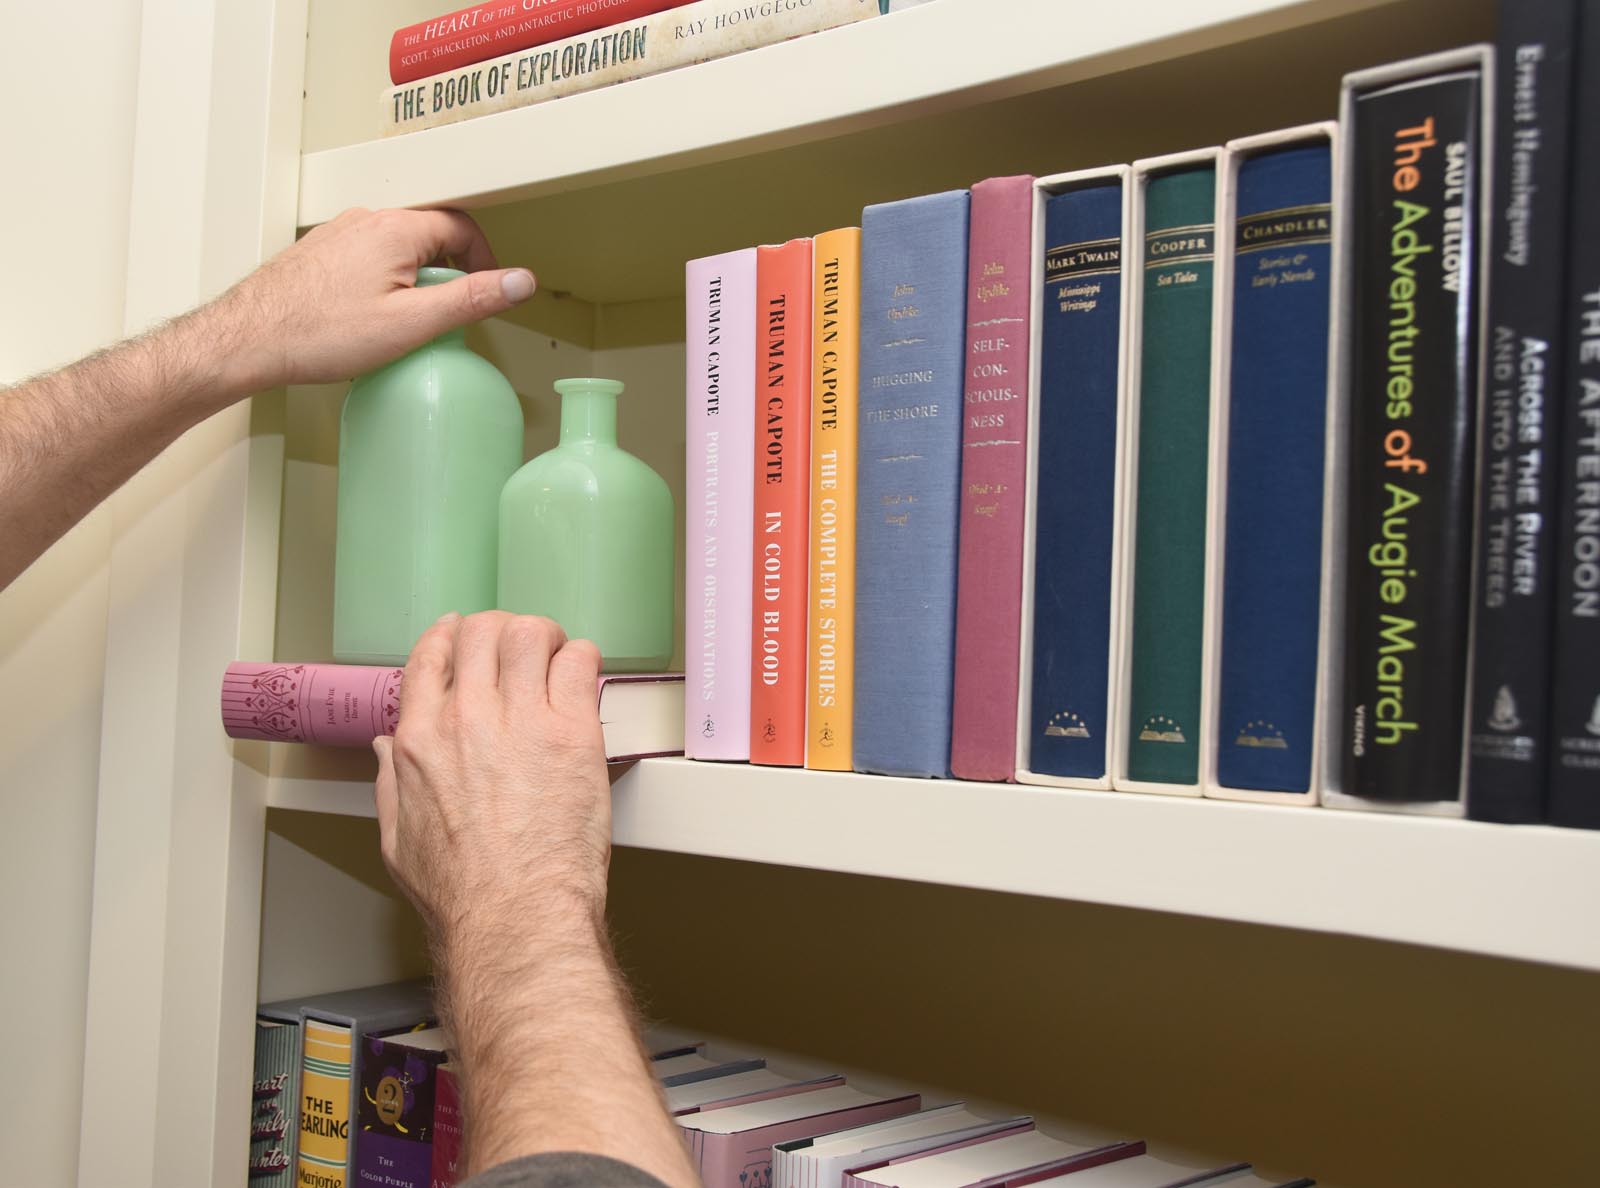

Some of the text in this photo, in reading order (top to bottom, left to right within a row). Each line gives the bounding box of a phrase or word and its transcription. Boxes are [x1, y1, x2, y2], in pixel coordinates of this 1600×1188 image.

[403, 6, 516, 47] THE HEART OF THE
[495, 25, 516, 40] AND
[518, 9, 574, 33] ANTARCTIC
[674, 19, 707, 40] RAY
[393, 26, 647, 123] THE BOOK OF EXPLORATION
[1504, 44, 1544, 266] Ernest Hemingway
[1243, 217, 1328, 240] CHANDLER
[1442, 141, 1466, 293] SAUL BELLOW
[1151, 237, 1207, 255] COOPER
[1046, 251, 1119, 271] MARK TWAIN
[1157, 271, 1198, 287] Sea Tales
[972, 338, 1010, 353] SELF-
[1493, 326, 1514, 381] AND
[872, 370, 934, 388] HUGGING
[973, 363, 1008, 378] CON-
[866, 404, 939, 422] THE SHORE
[970, 414, 1005, 429] NESS
[1492, 390, 1512, 450] INTO
[1368, 116, 1438, 745] The Adventures of Augie March
[1513, 337, 1548, 595] ACROSS THE RIVER
[703, 276, 721, 701] TRUMAN CAPOTE PORTRAITS AND OBSERVATIONS
[762, 294, 786, 686] TRUMAN CAPOTE IN COLD BLOOD
[818, 258, 839, 707] TRUMAN CAPOTE THE COMPLETE STORIES
[1489, 457, 1510, 511] THE
[1572, 378, 1600, 618] AFTERNOON
[1353, 704, 1366, 757] VIKING
[254, 1073, 288, 1092] eart
[305, 1096, 333, 1115] THE
[253, 1110, 291, 1138] nely
[301, 1113, 349, 1139] EARLING
[250, 1147, 290, 1167] unter
[378, 1156, 394, 1167] THE
[360, 1168, 414, 1188] COLOR PURPLE
